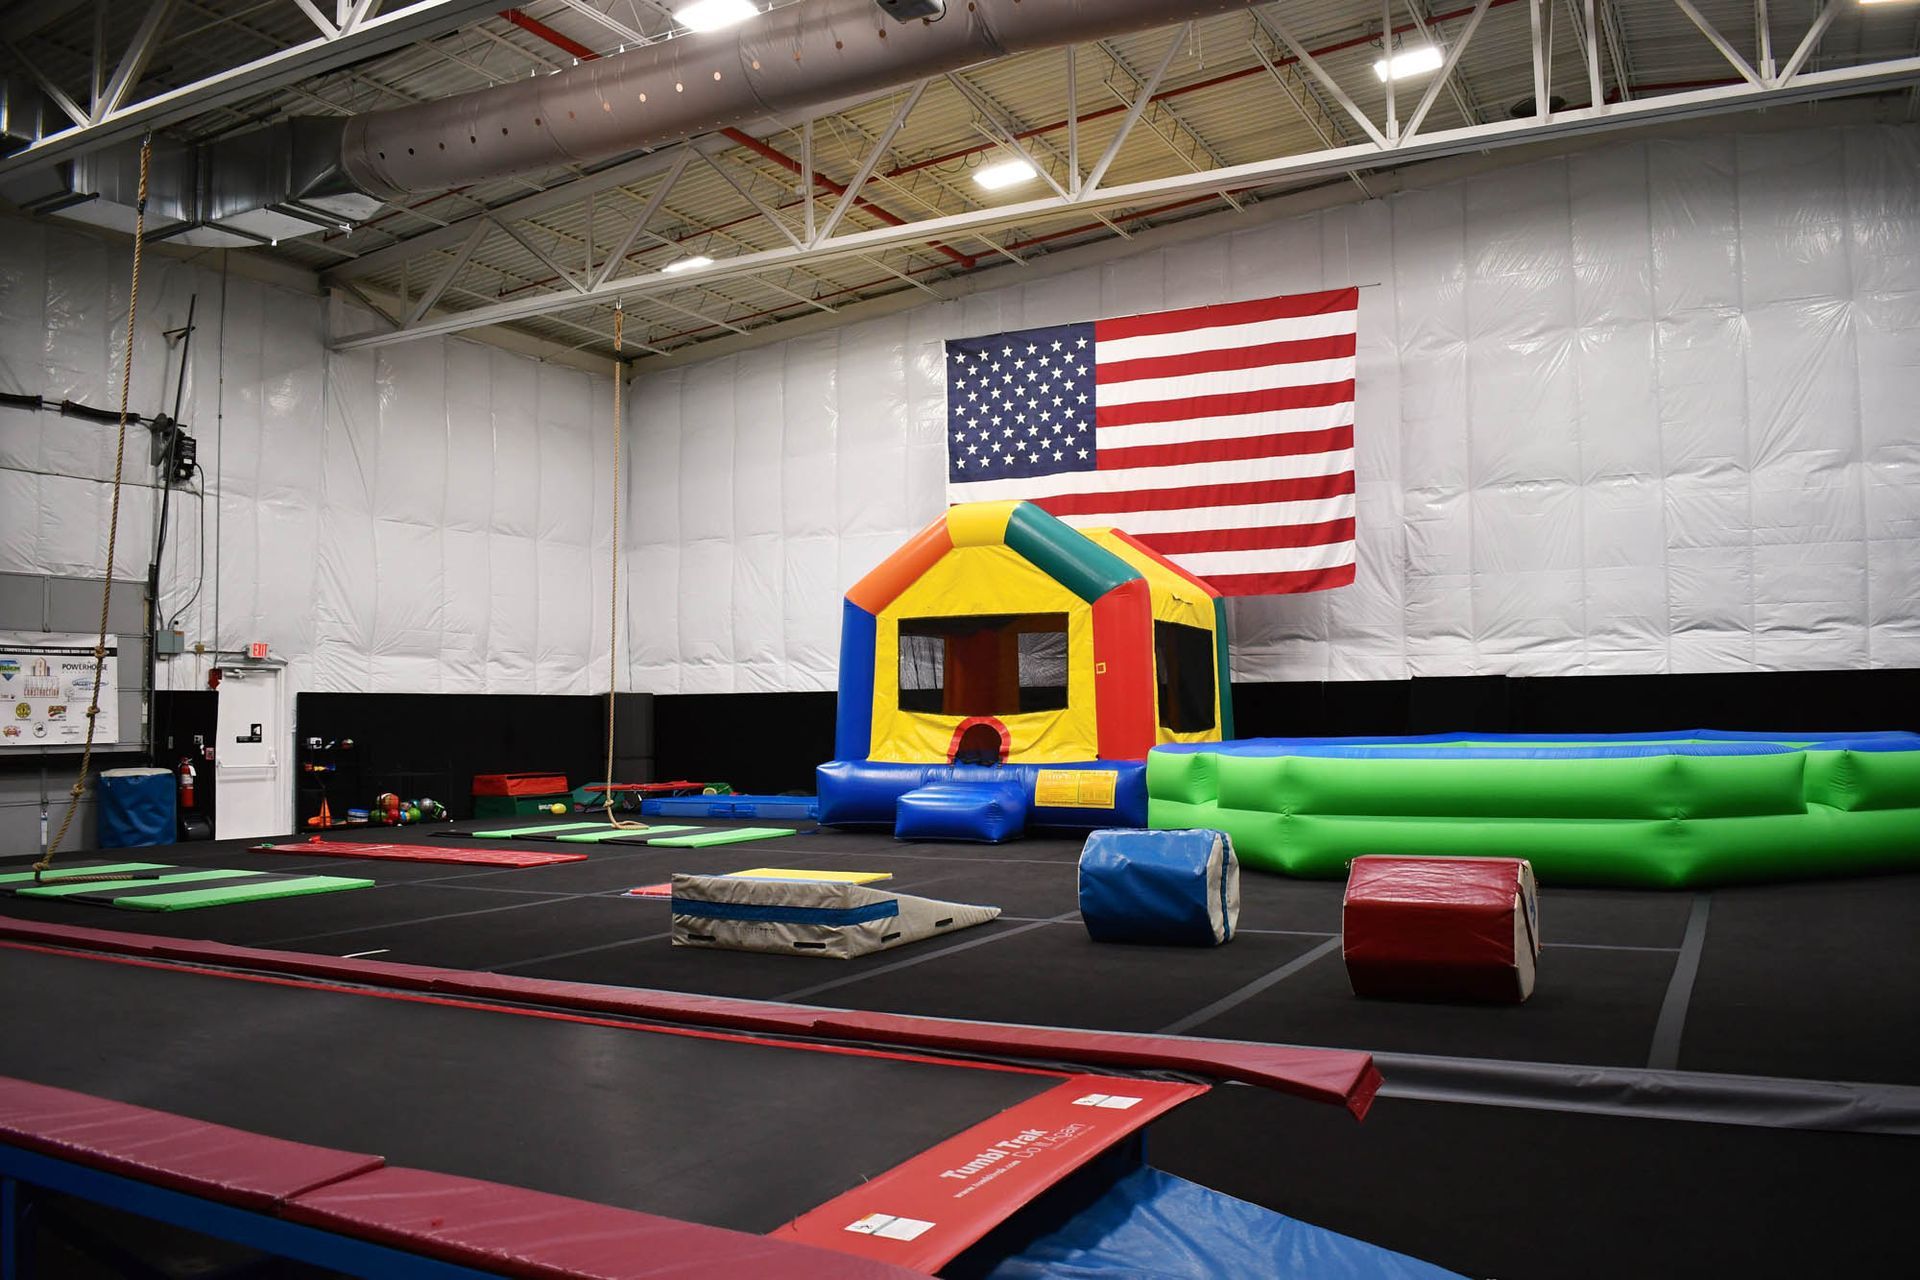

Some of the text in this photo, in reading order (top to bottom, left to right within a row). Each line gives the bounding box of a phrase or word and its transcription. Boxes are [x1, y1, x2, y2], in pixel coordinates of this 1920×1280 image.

[253, 642, 267, 657] EXIT
[62, 663, 108, 671] POWERHOSE
[24, 687, 59, 697] CONSTRUCTION
[1011, 1147, 1042, 1158] Do
[1043, 1123, 1086, 1144] Again
[939, 1148, 1010, 1179] Tumbl
[995, 1128, 1049, 1149] Trak
